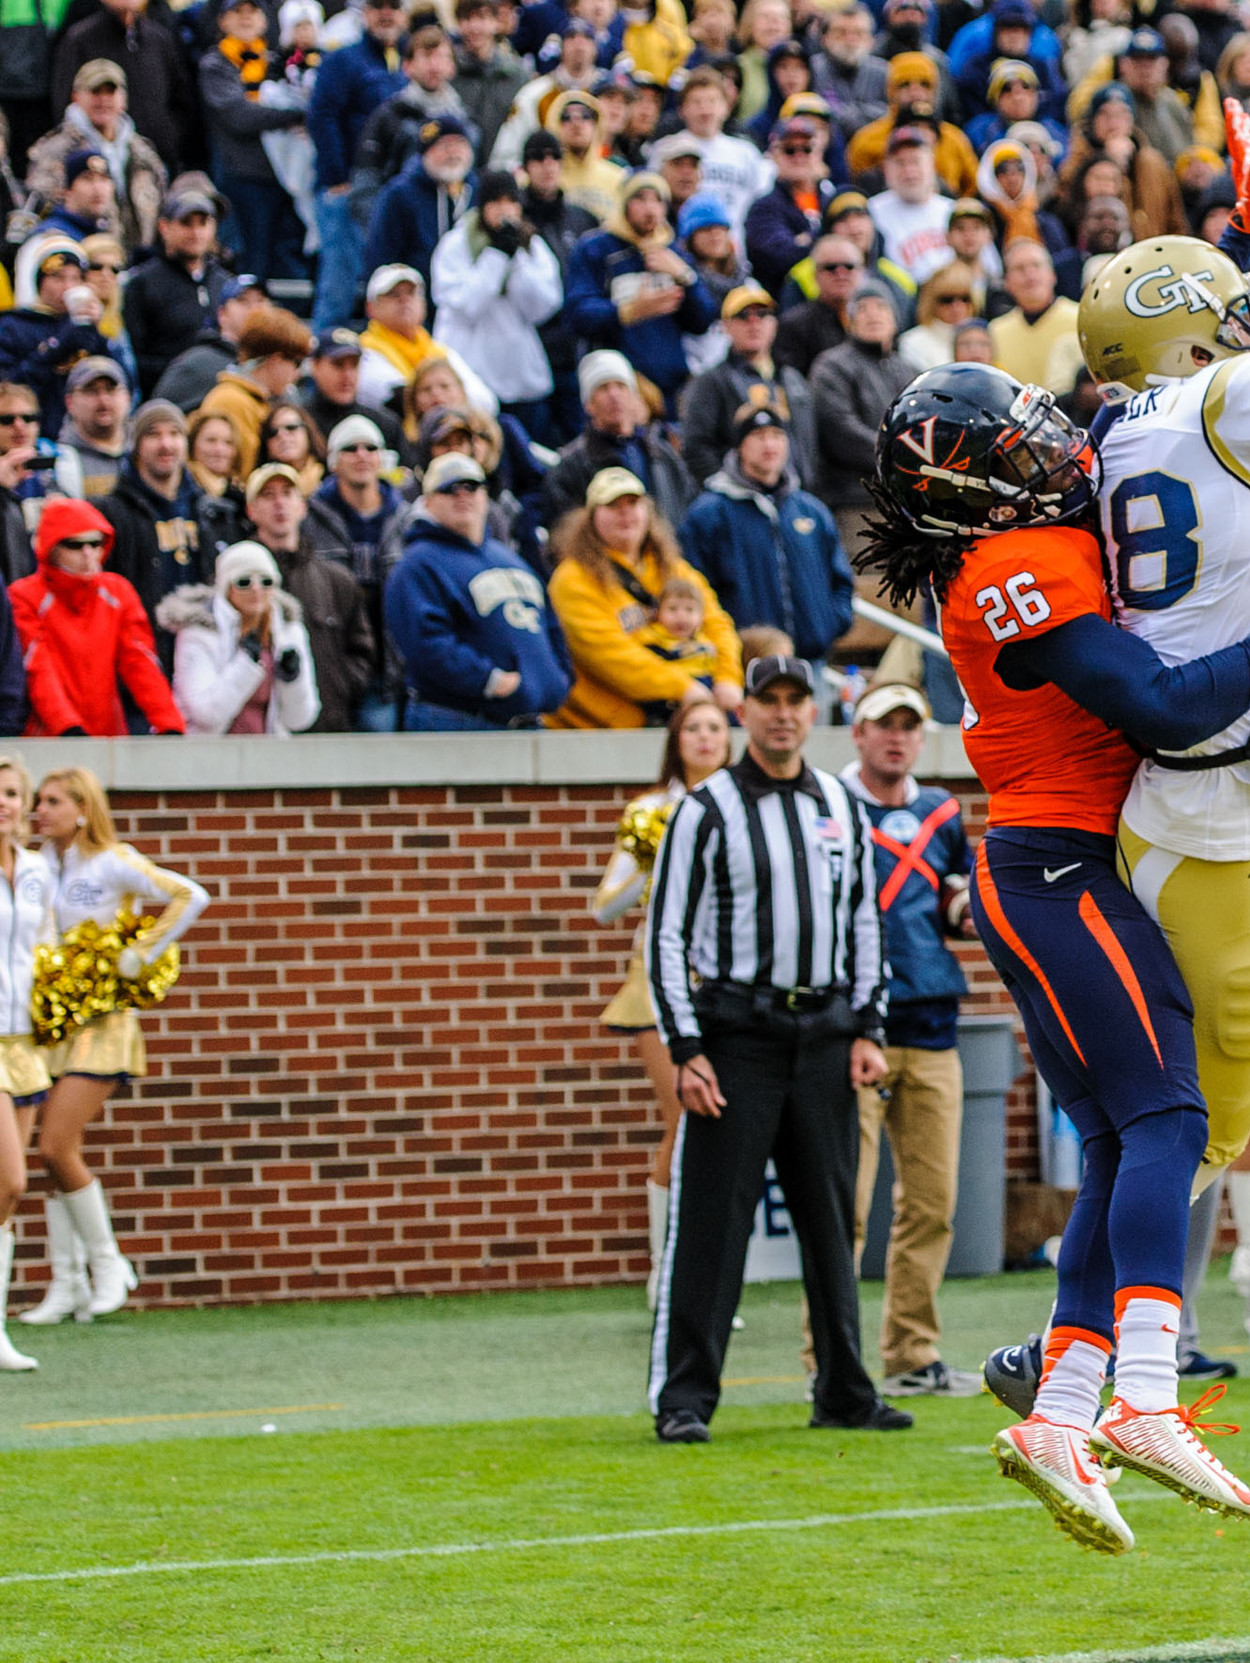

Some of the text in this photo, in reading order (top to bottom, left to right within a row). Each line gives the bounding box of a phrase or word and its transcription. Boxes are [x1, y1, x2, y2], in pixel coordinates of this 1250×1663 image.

[1118, 385, 1169, 422] ER
[1098, 467, 1203, 613] 8
[975, 571, 1051, 643] 26
